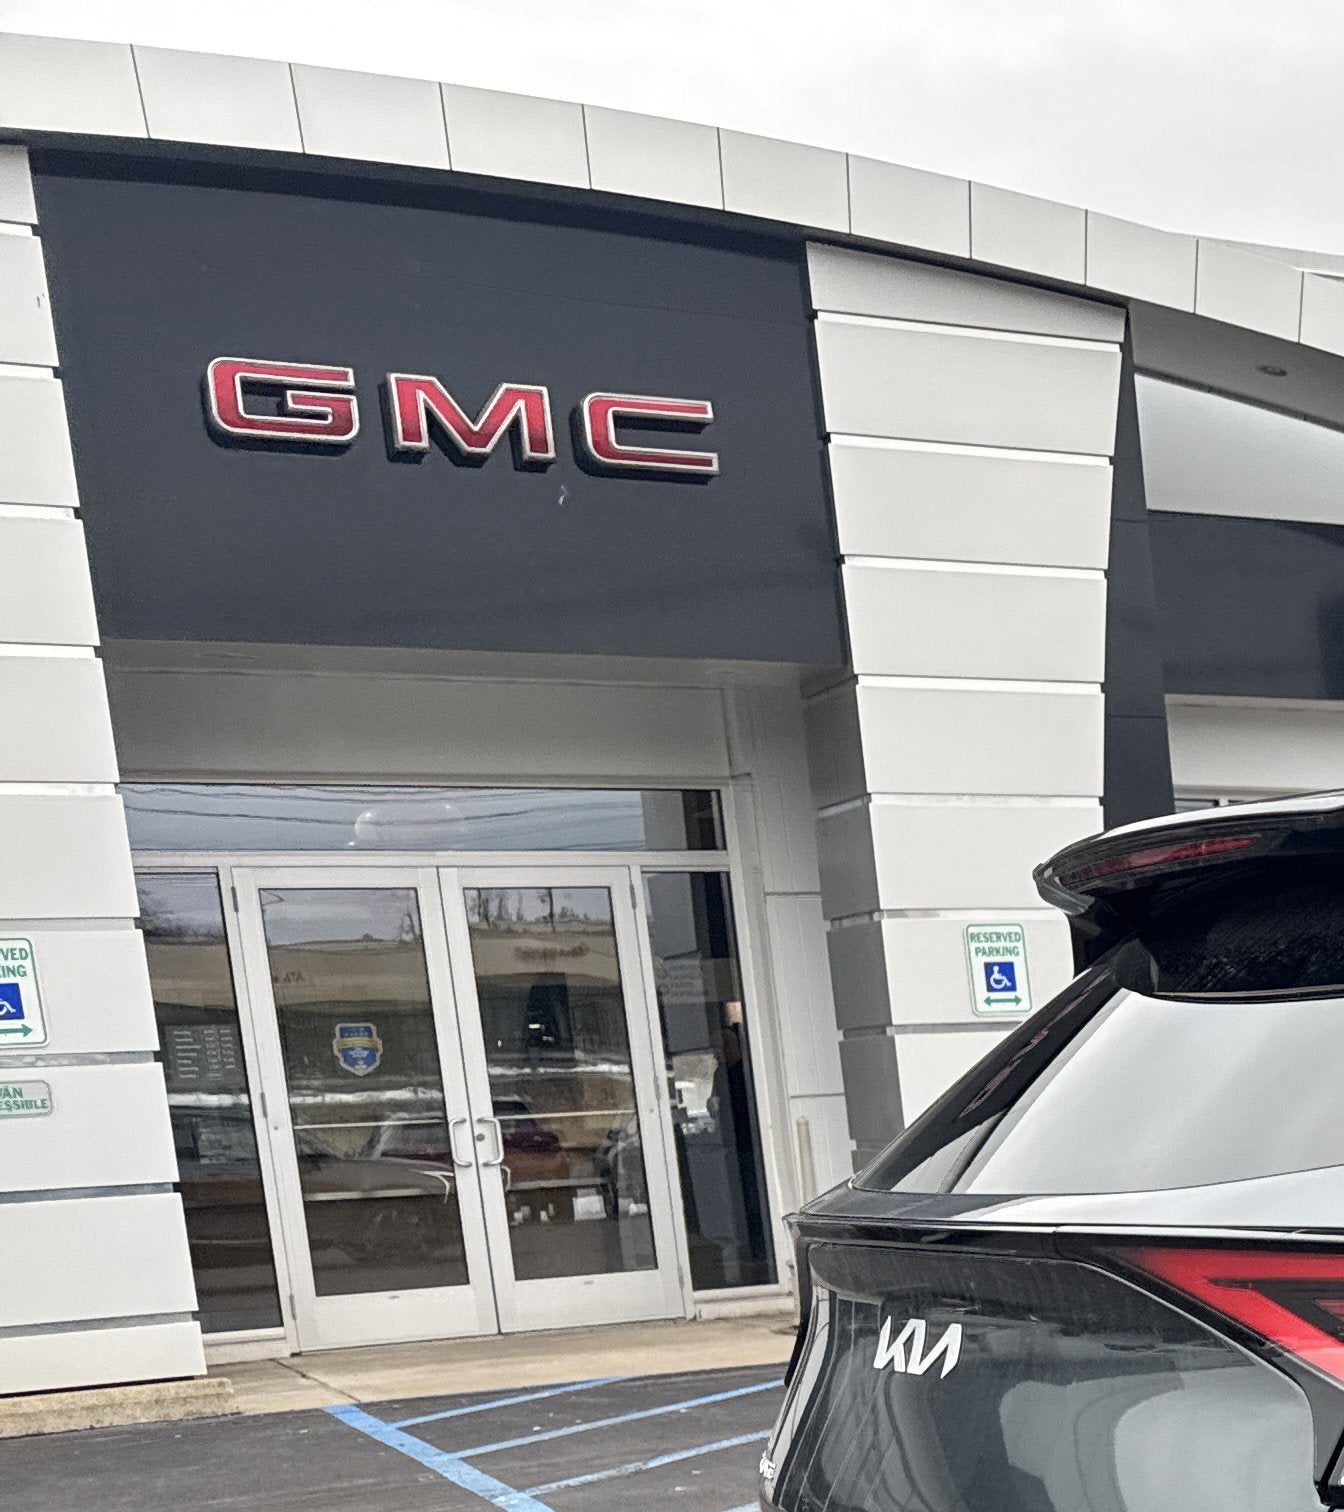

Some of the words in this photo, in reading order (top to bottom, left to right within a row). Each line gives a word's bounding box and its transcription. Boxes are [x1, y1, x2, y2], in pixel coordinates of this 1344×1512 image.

[207, 356, 720, 474] GMC
[970, 931, 1022, 943] RESERVED
[0, 947, 29, 961] VED
[974, 945, 1020, 957] PARKING
[0, 964, 27, 979] ING
[873, 1315, 963, 1380] KIA
